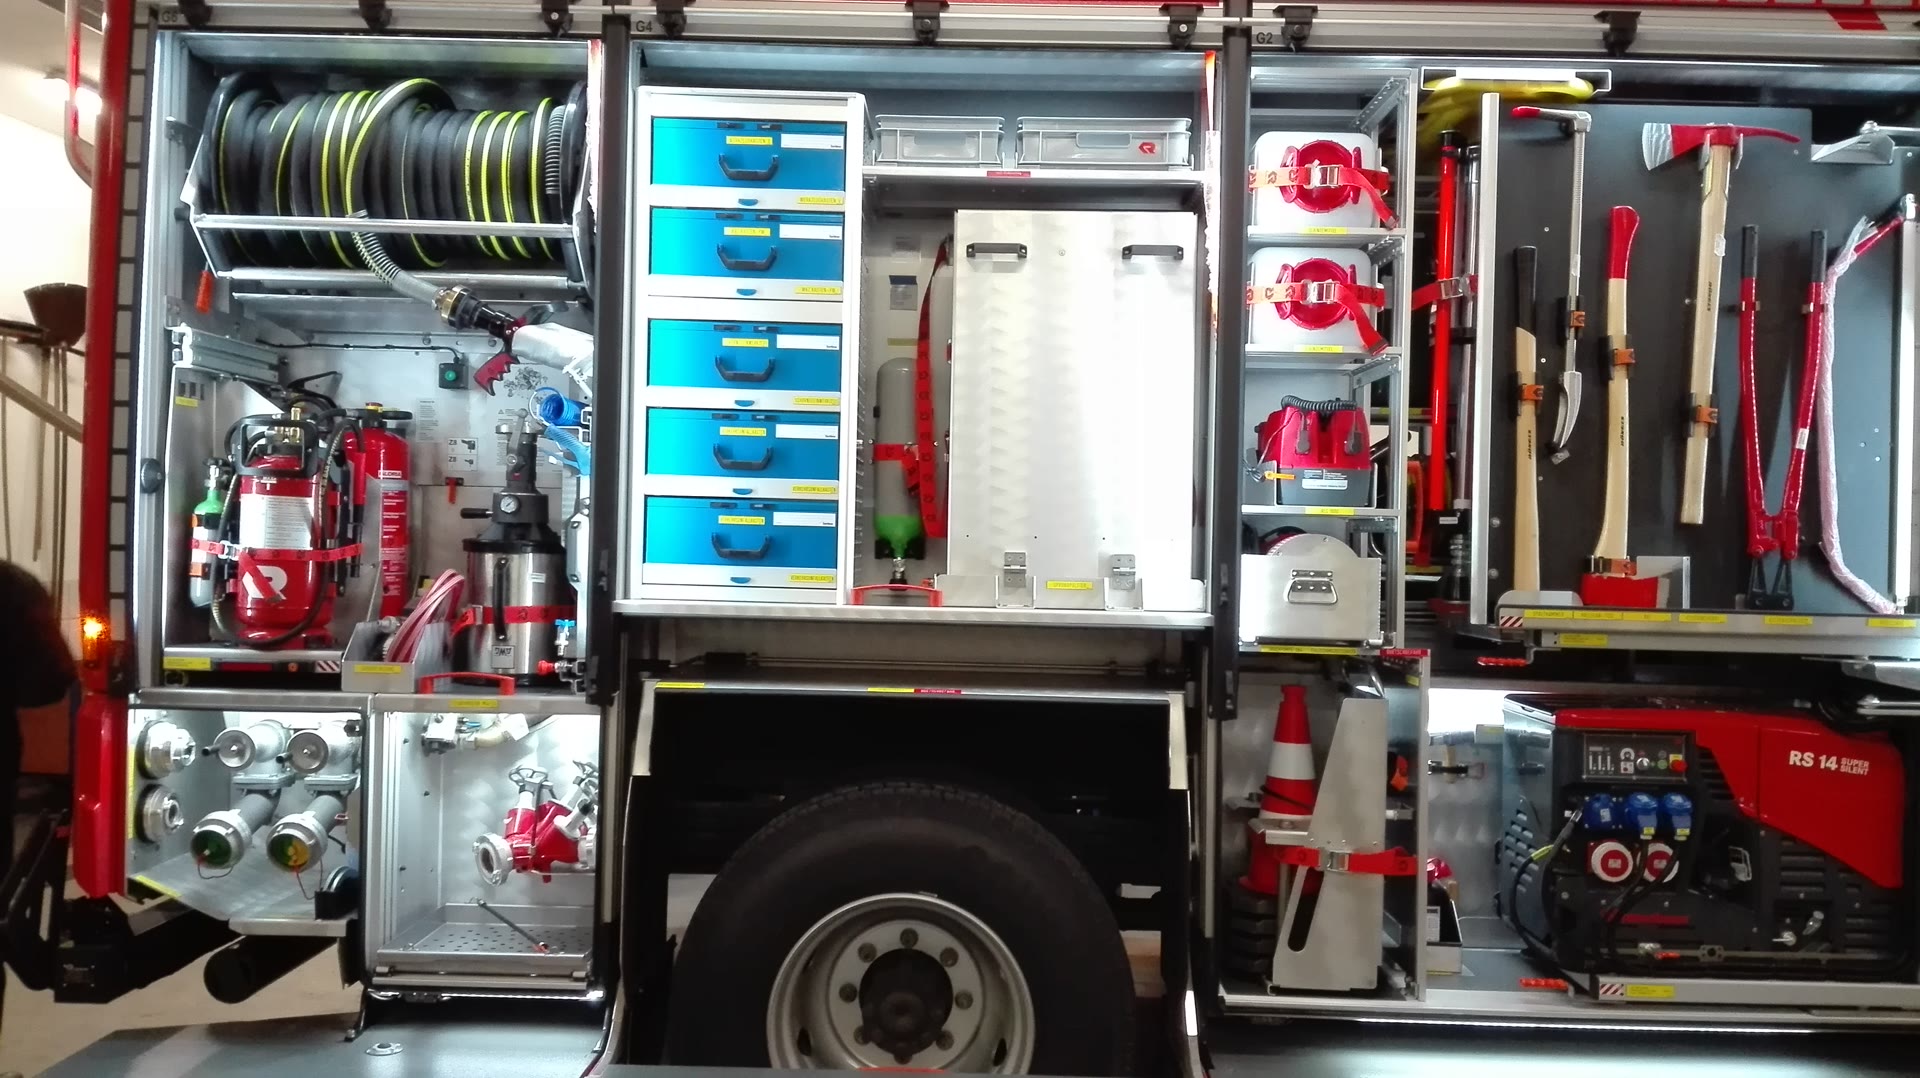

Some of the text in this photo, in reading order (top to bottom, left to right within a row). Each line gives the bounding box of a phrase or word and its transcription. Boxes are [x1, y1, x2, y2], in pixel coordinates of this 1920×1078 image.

[635, 20, 653, 33] G4
[1256, 31, 1273, 44] G2
[1789, 750, 1839, 771] RS 14
[1840, 757, 1870, 768] SUPER
[1839, 765, 1869, 776] SILENT
